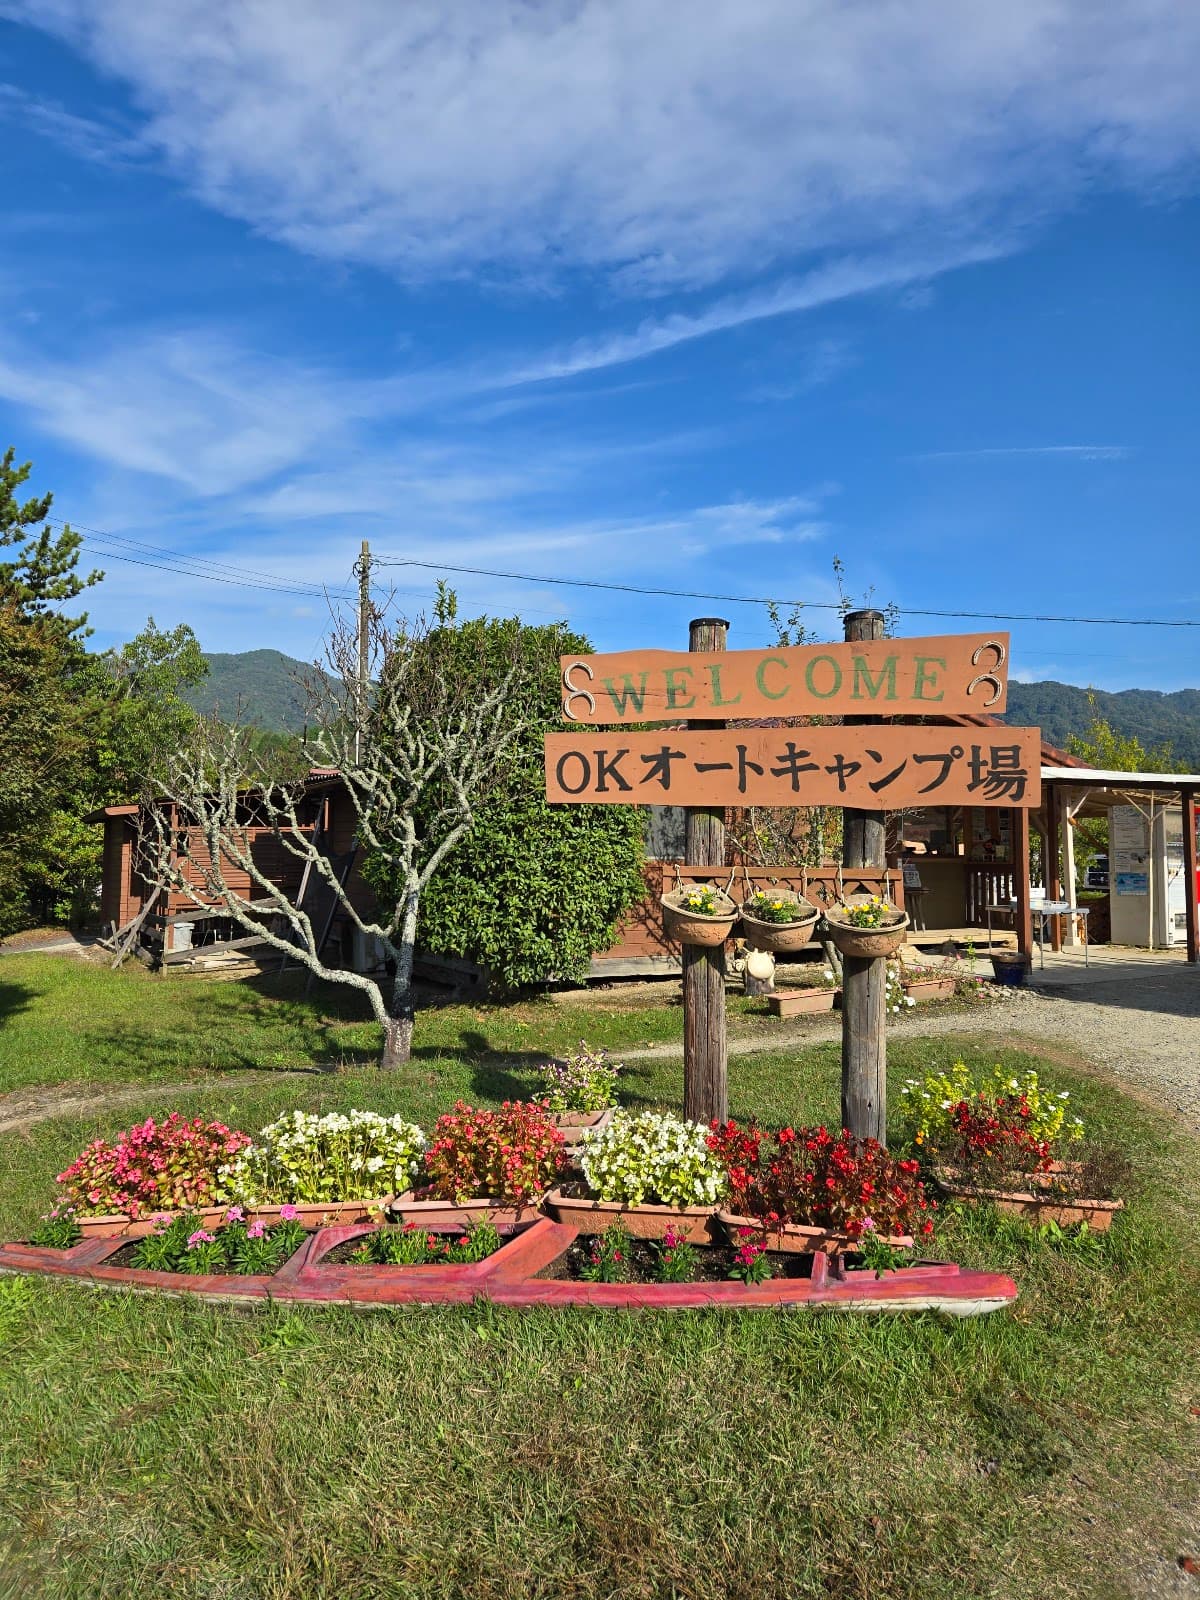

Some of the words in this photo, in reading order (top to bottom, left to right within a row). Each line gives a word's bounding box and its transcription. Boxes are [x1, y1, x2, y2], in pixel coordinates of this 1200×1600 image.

[603, 656, 947, 716] WELCOME
[556, 743, 1028, 802] OKオートキャンプ場
